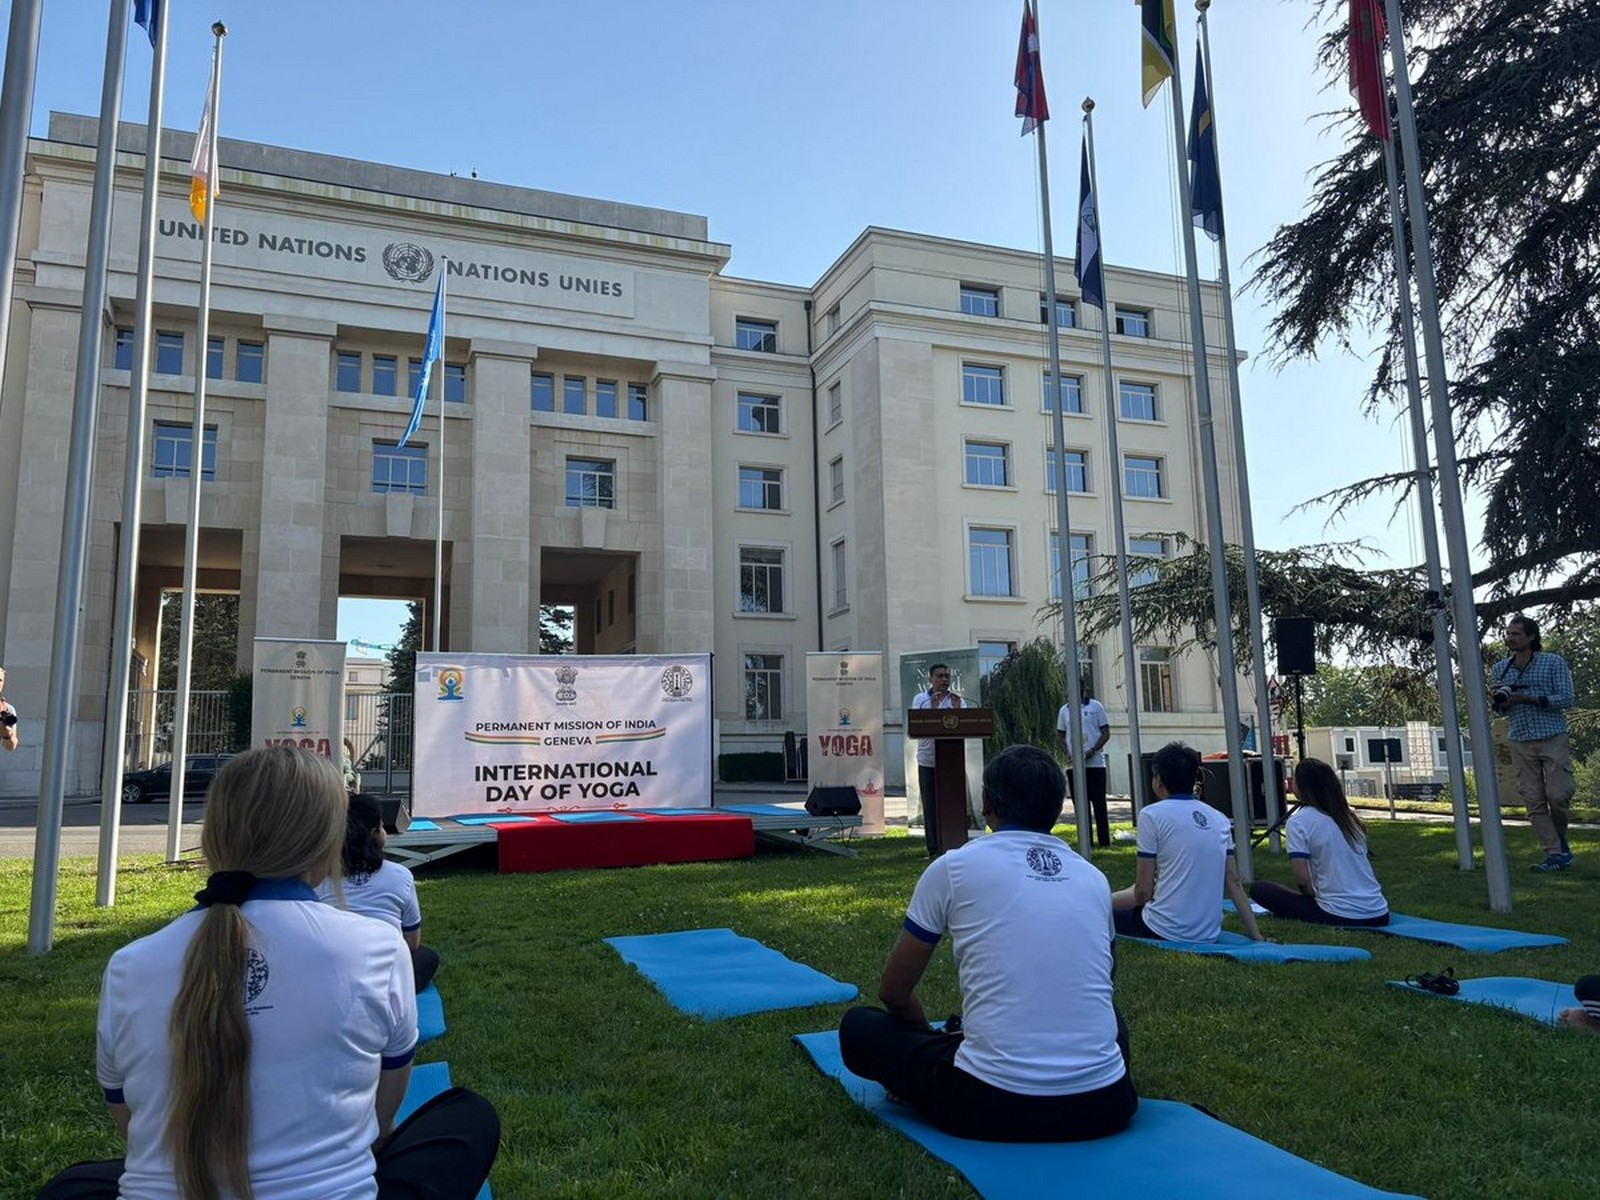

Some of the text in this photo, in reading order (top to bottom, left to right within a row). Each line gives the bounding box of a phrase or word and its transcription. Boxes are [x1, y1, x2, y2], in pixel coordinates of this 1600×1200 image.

[259, 233, 366, 263] NATIONS
[447, 260, 622, 298] NATIONS UNIES
[476, 719, 657, 732] PERMANENT MISSION OF INDIA
[544, 736, 592, 746] GENEVA
[819, 734, 873, 757] YOGA
[475, 761, 658, 782] INTERNATIONAL
[486, 781, 641, 802] DAY OF YOGA
